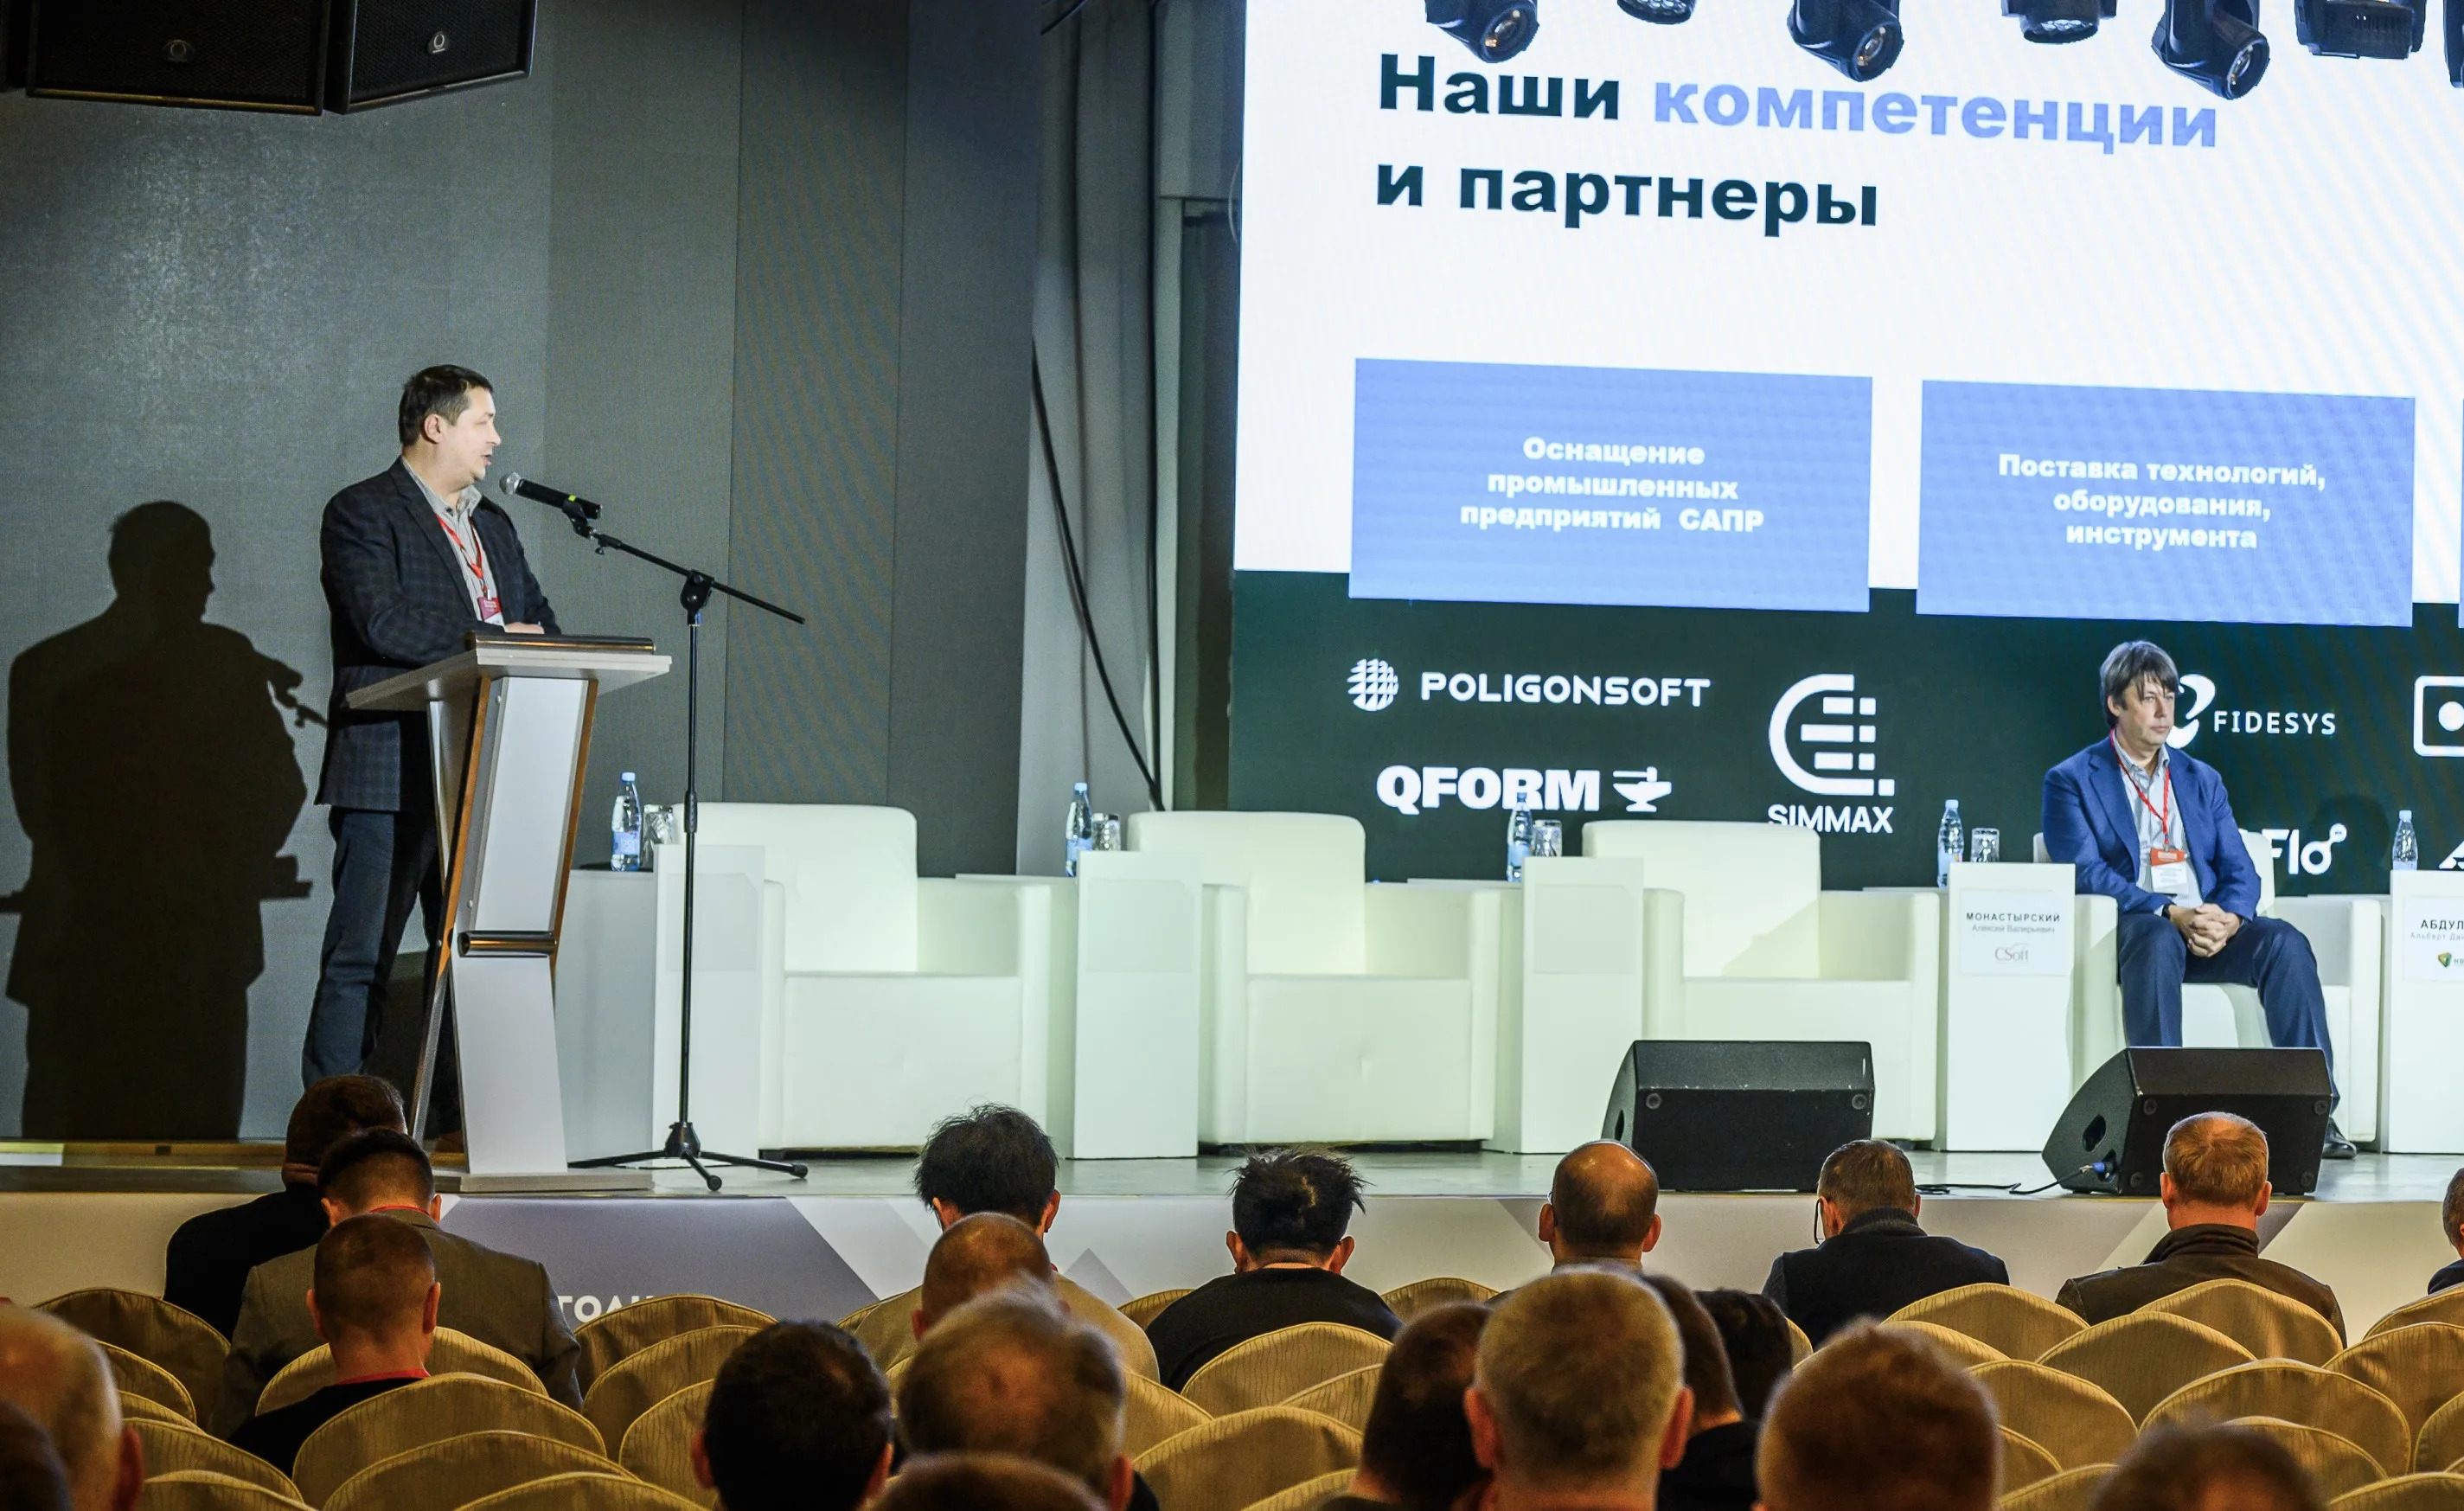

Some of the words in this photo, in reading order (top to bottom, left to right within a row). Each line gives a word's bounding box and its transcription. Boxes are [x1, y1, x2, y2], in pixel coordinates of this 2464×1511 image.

[1379, 54, 1620, 120] Наши
[1654, 79, 2218, 155] компетенции
[1377, 163, 1424, 207] и
[1460, 168, 1878, 238] партнеры
[1523, 437, 1706, 466] Оснащение
[1488, 473, 1738, 500] промышленных
[1999, 453, 2139, 481] Поставка
[2146, 463, 2326, 491] технологий,
[1460, 505, 1661, 532] предприятий
[1679, 508, 1764, 533] САПР
[2053, 489, 2271, 522] оборудования,
[2065, 524, 2258, 552] инструмента
[1421, 671, 1712, 707] POLIGONSOFT
[2213, 710, 2337, 736] FIDESYS
[1376, 765, 1601, 815] QFORM
[1767, 804, 1894, 834] SIMMAX
[1966, 912, 2061, 922] МОНАСТЫРСКИЙ
